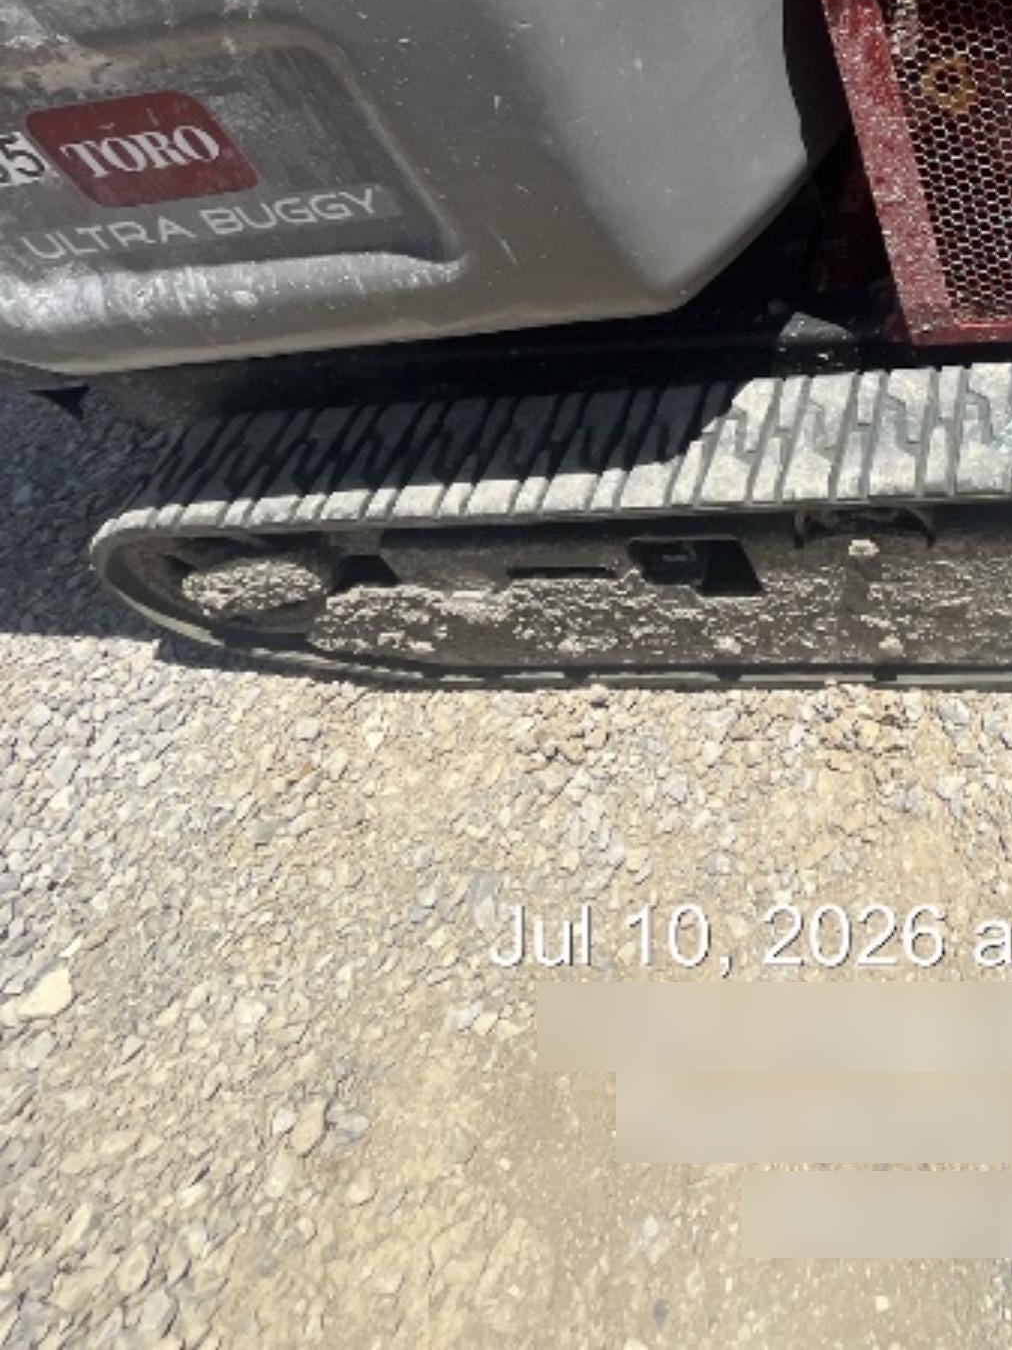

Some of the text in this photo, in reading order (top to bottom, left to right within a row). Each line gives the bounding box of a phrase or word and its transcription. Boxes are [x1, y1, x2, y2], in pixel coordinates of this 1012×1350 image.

[0, 134, 46, 183] 5
[60, 124, 220, 178] TORO
[20, 188, 376, 259] ULTRA BUGGY
